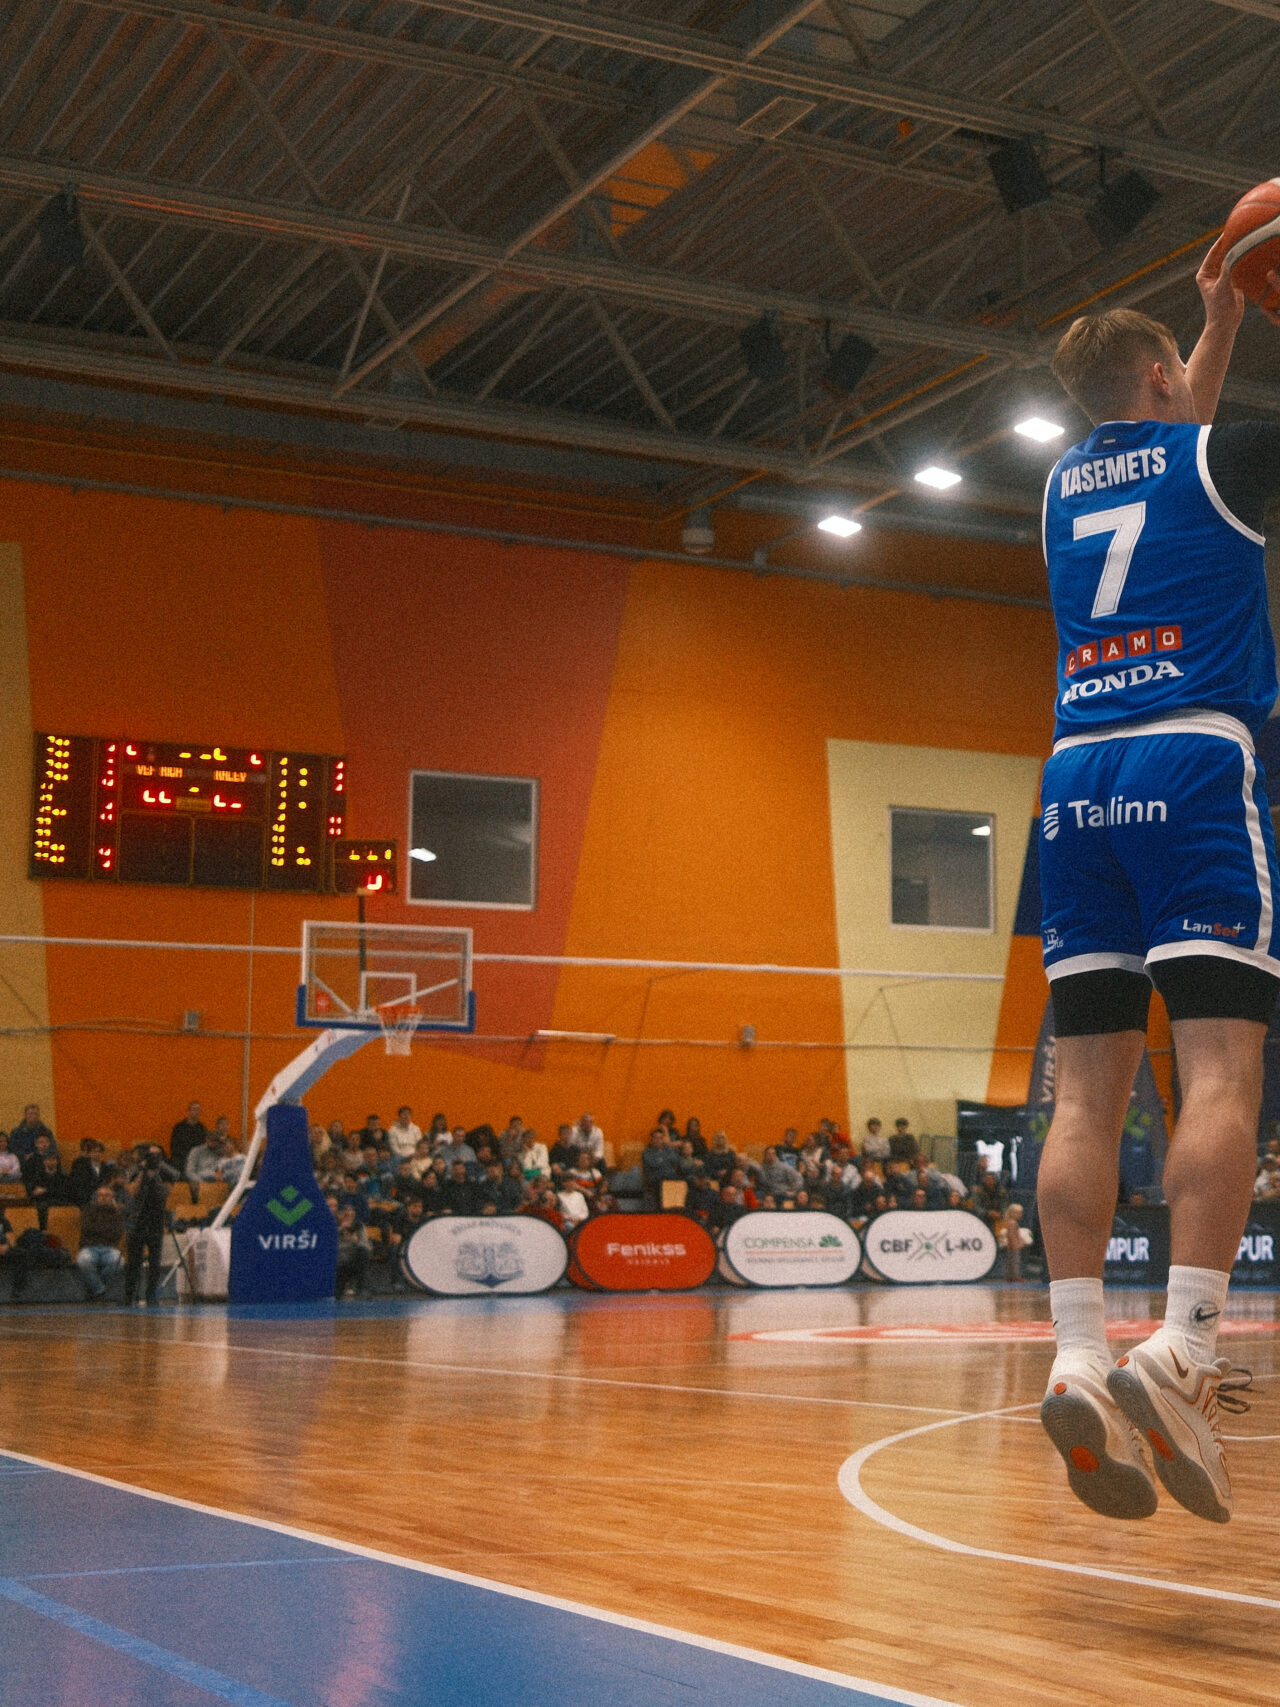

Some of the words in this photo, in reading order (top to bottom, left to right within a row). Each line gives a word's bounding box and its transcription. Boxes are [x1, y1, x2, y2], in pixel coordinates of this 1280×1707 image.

[1061, 446, 1167, 499] KASEMETS
[1073, 501, 1147, 619] 7
[1066, 628, 1177, 673] CRAMO
[1061, 661, 1184, 705] HONDA
[1068, 795, 1167, 829] Tallinn
[259, 1230, 318, 1250] VIRŠI
[607, 1242, 687, 1257] Fenikss
[745, 1237, 815, 1249] COMPENSA
[880, 1239, 914, 1254] CBF
[1106, 1236, 1149, 1261] MPUR
